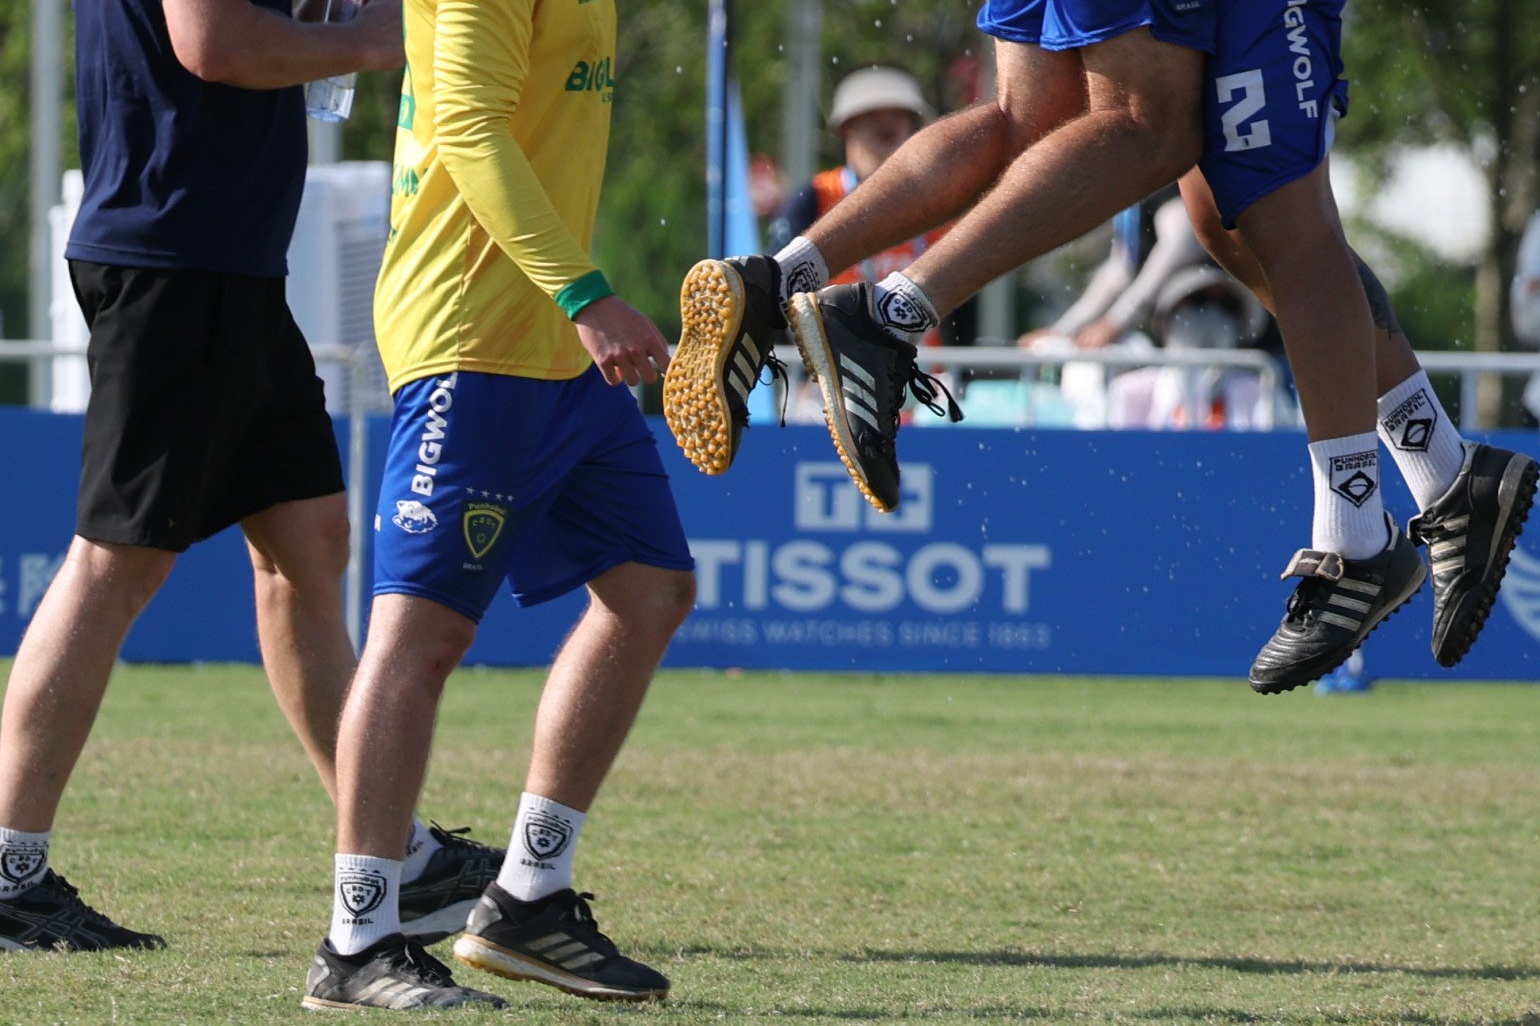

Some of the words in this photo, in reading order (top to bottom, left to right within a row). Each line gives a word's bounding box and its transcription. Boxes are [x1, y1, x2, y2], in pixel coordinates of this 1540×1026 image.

[1215, 68, 1272, 152] 2
[410, 371, 459, 497] BIGWOL
[687, 538, 1052, 614] TISSOT
[763, 619, 894, 647] WATCHES
[899, 620, 981, 647] SINCE
